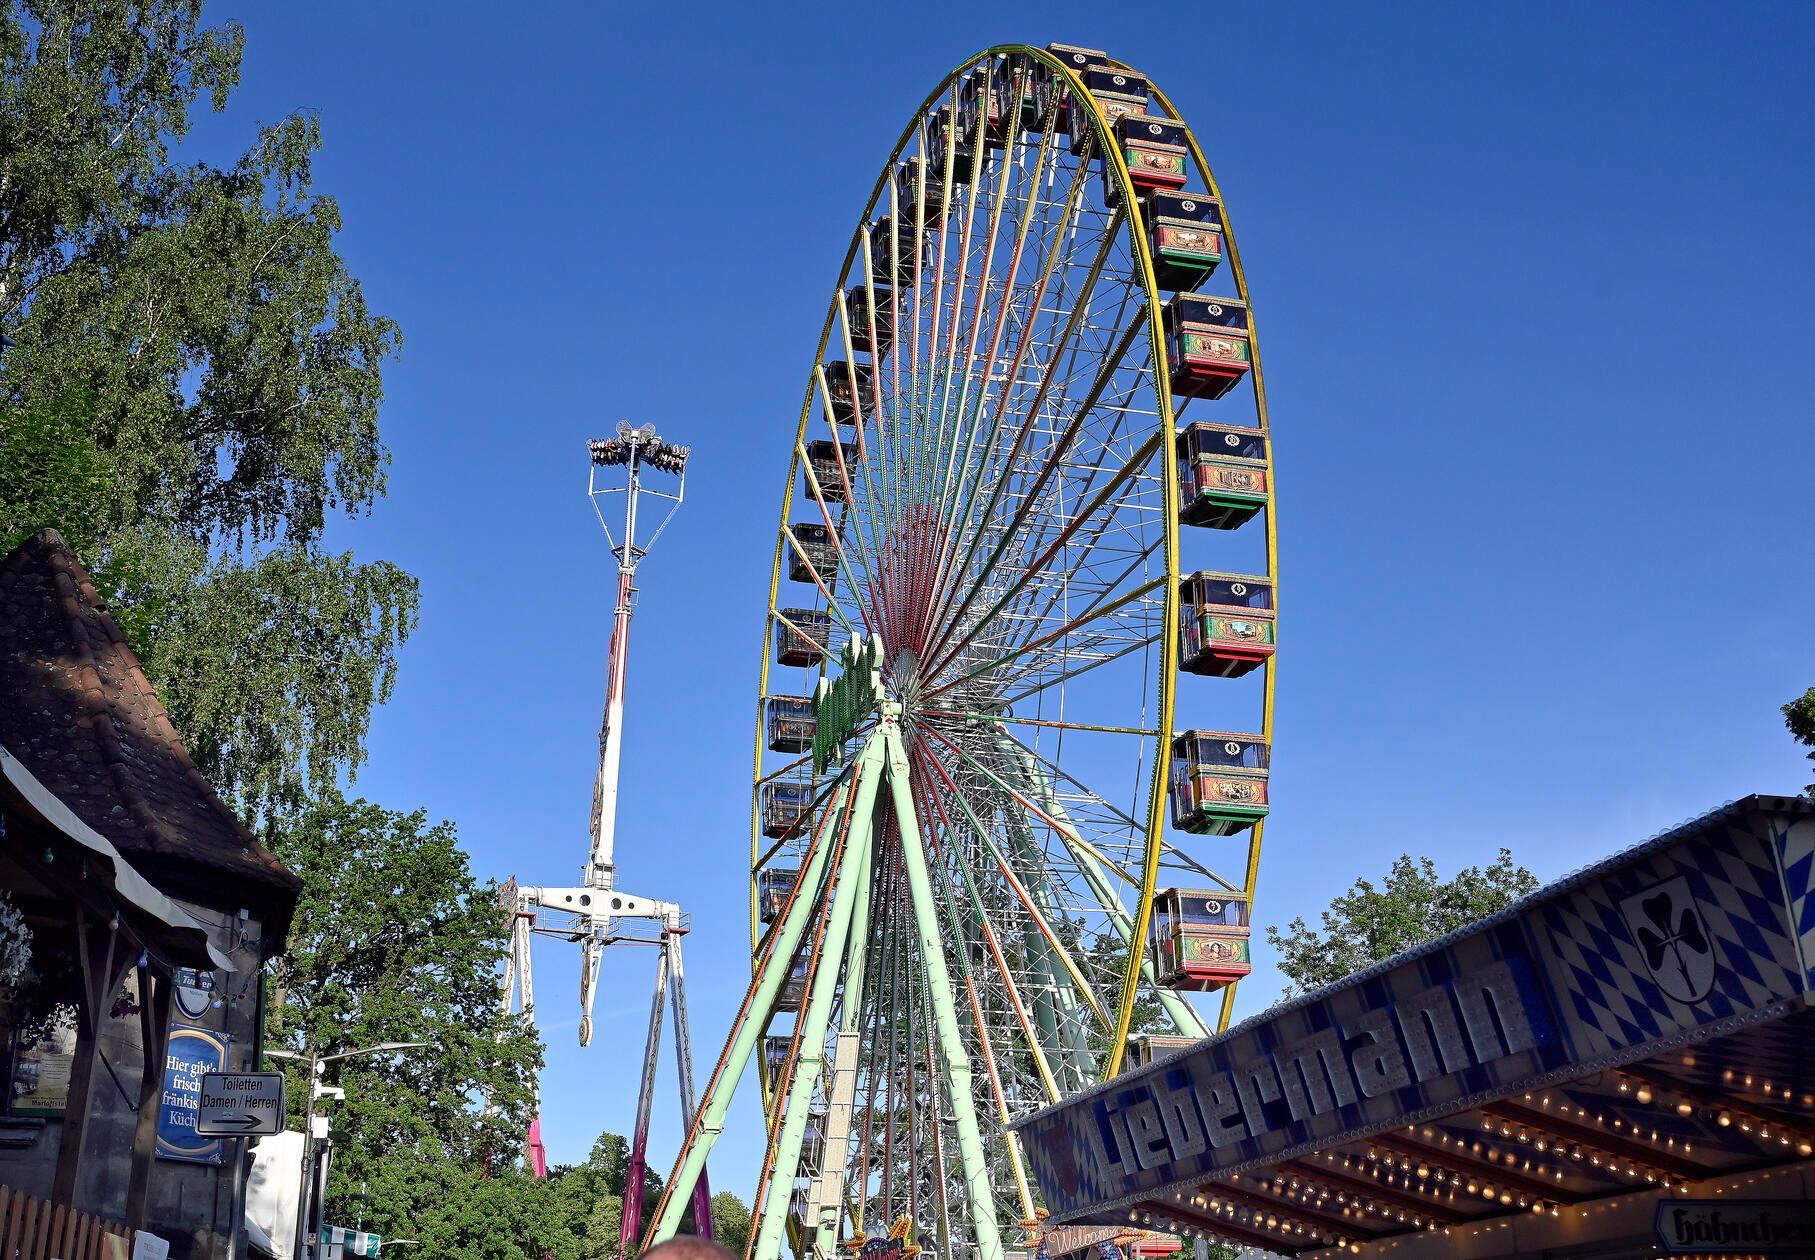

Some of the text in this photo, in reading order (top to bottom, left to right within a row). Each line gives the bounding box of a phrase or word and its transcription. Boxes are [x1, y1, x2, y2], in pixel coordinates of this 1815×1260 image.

[166, 1055, 217, 1077] Hier gibt's
[1086, 961, 1537, 1181] Liebermann
[173, 1075, 201, 1092] frisch
[222, 1077, 263, 1091] Toiletten
[162, 1091, 198, 1110] fränkis
[203, 1095, 277, 1109] Damen / Herren
[168, 1110, 196, 1128] Küch
[1049, 1227, 1118, 1253] Welcome
